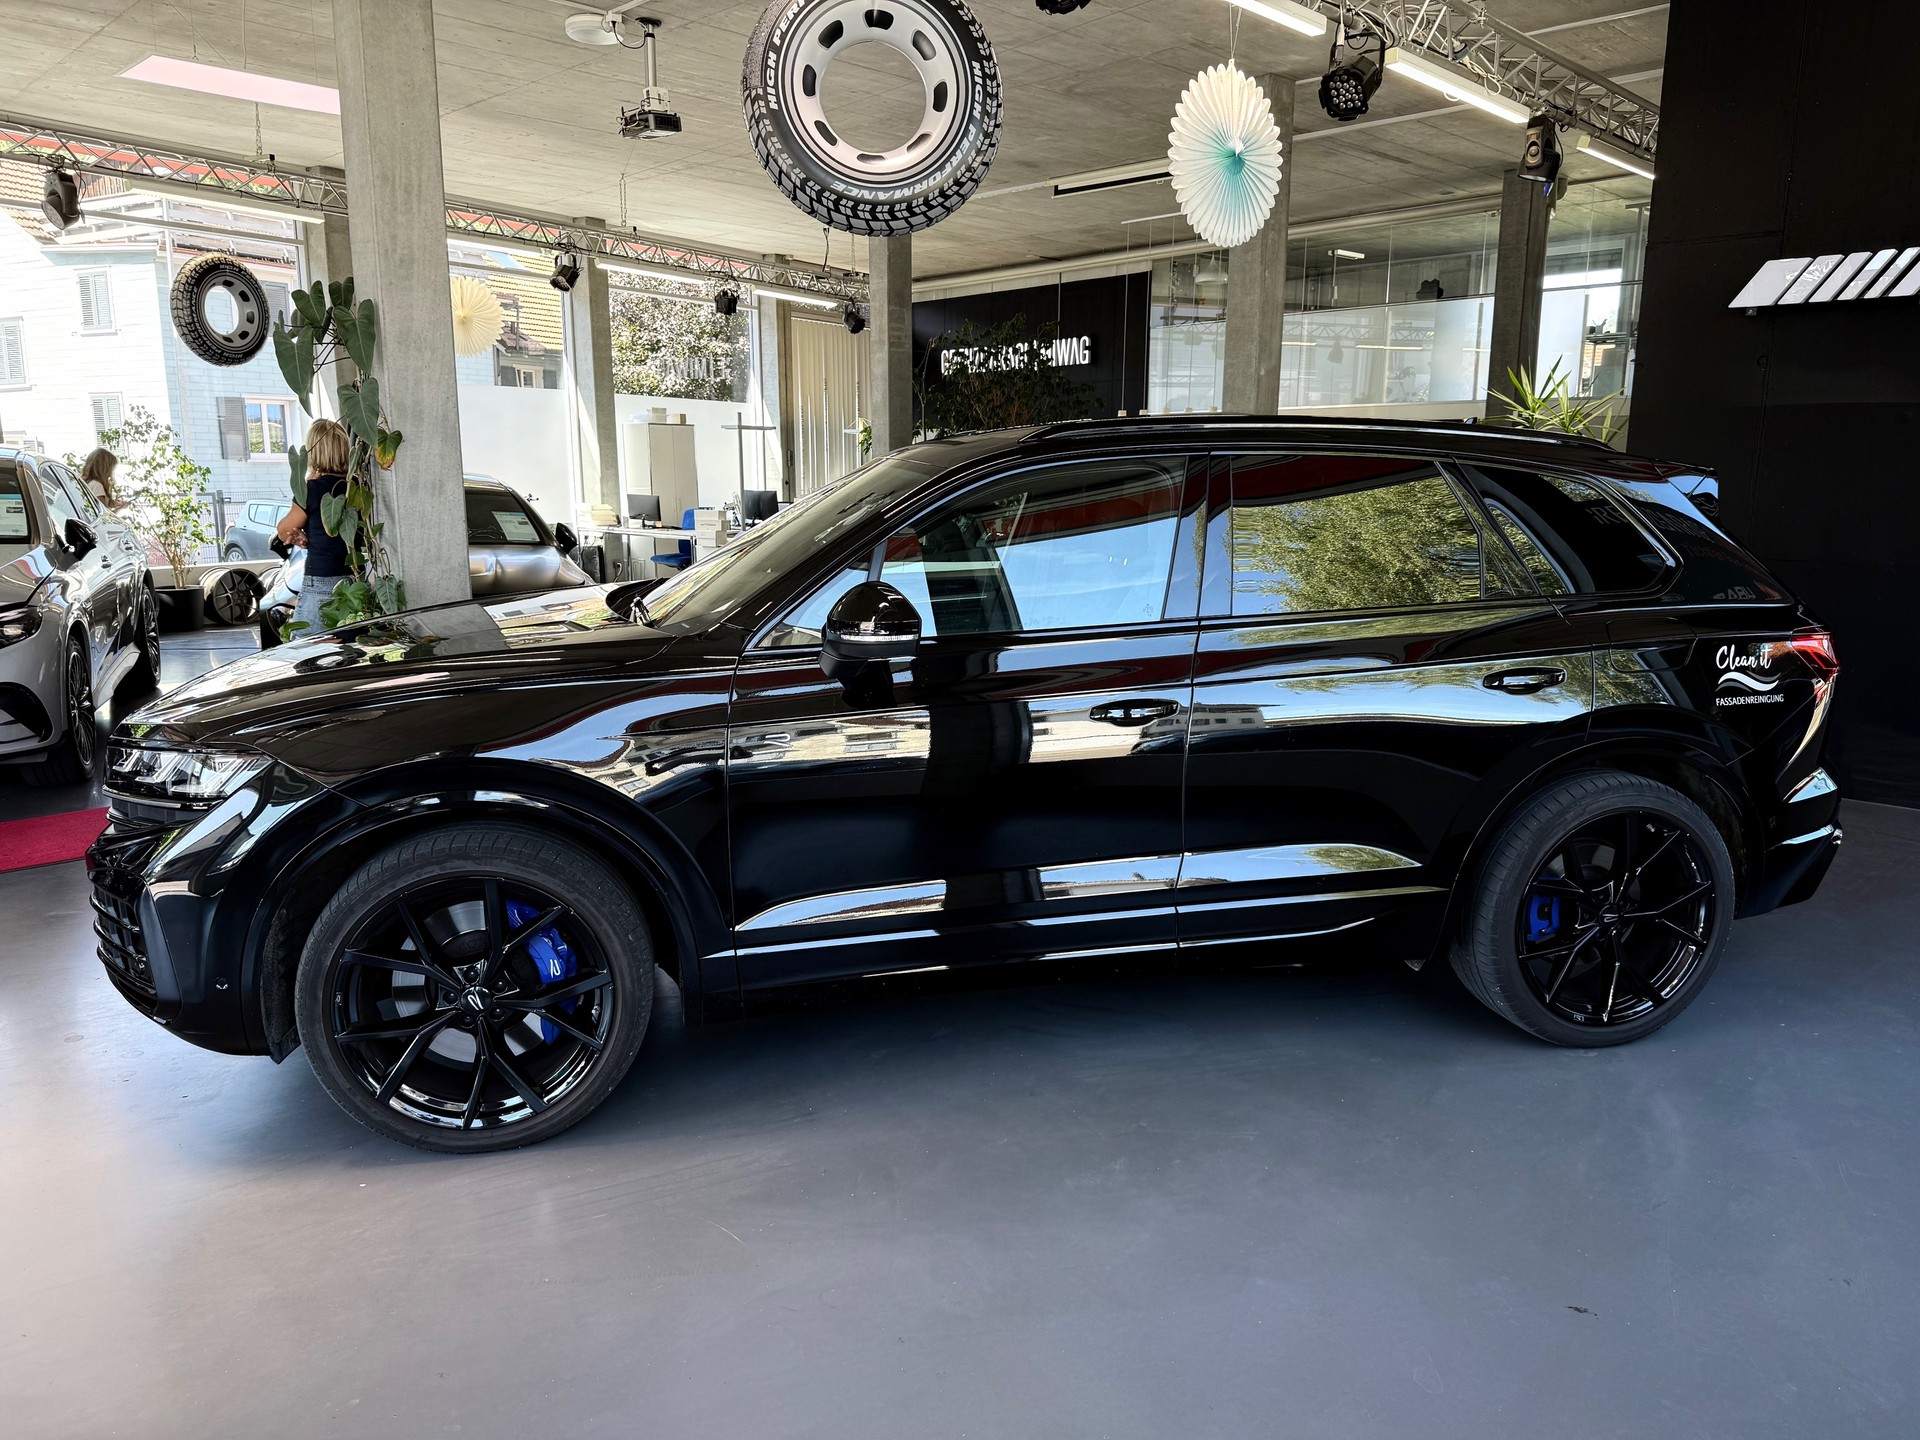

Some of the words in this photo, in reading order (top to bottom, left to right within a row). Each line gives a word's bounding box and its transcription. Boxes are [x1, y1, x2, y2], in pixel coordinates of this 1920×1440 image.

[766, 51, 780, 110] HIGH
[971, 60, 984, 118] HIGH
[831, 124, 976, 200] PERFORMANCE
[1716, 644, 1758, 670] Clean
[1760, 645, 1773, 669] it
[1716, 694, 1785, 706] FASSADENREINIGUNG
